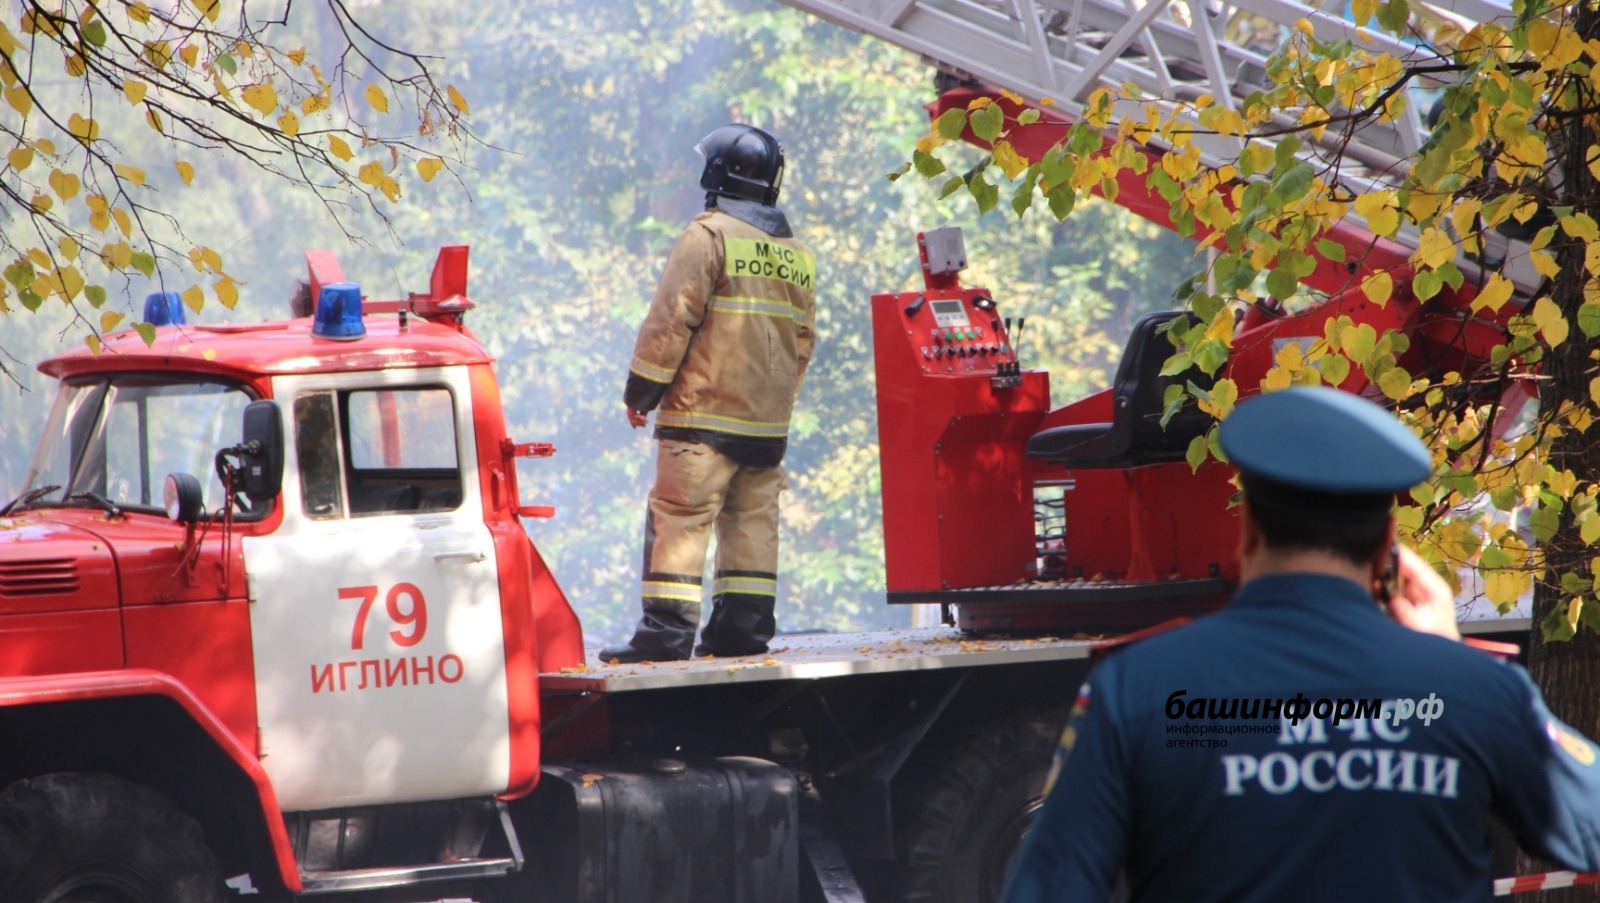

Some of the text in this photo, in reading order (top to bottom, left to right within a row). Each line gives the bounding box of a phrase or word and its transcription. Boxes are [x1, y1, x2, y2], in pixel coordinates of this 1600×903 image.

[735, 259, 810, 288] РОССИИ
[755, 242, 794, 264] МЧС
[338, 582, 428, 650] 79
[310, 653, 464, 694] ИГЛИНО
[1222, 749, 1460, 800] РОССИИ
